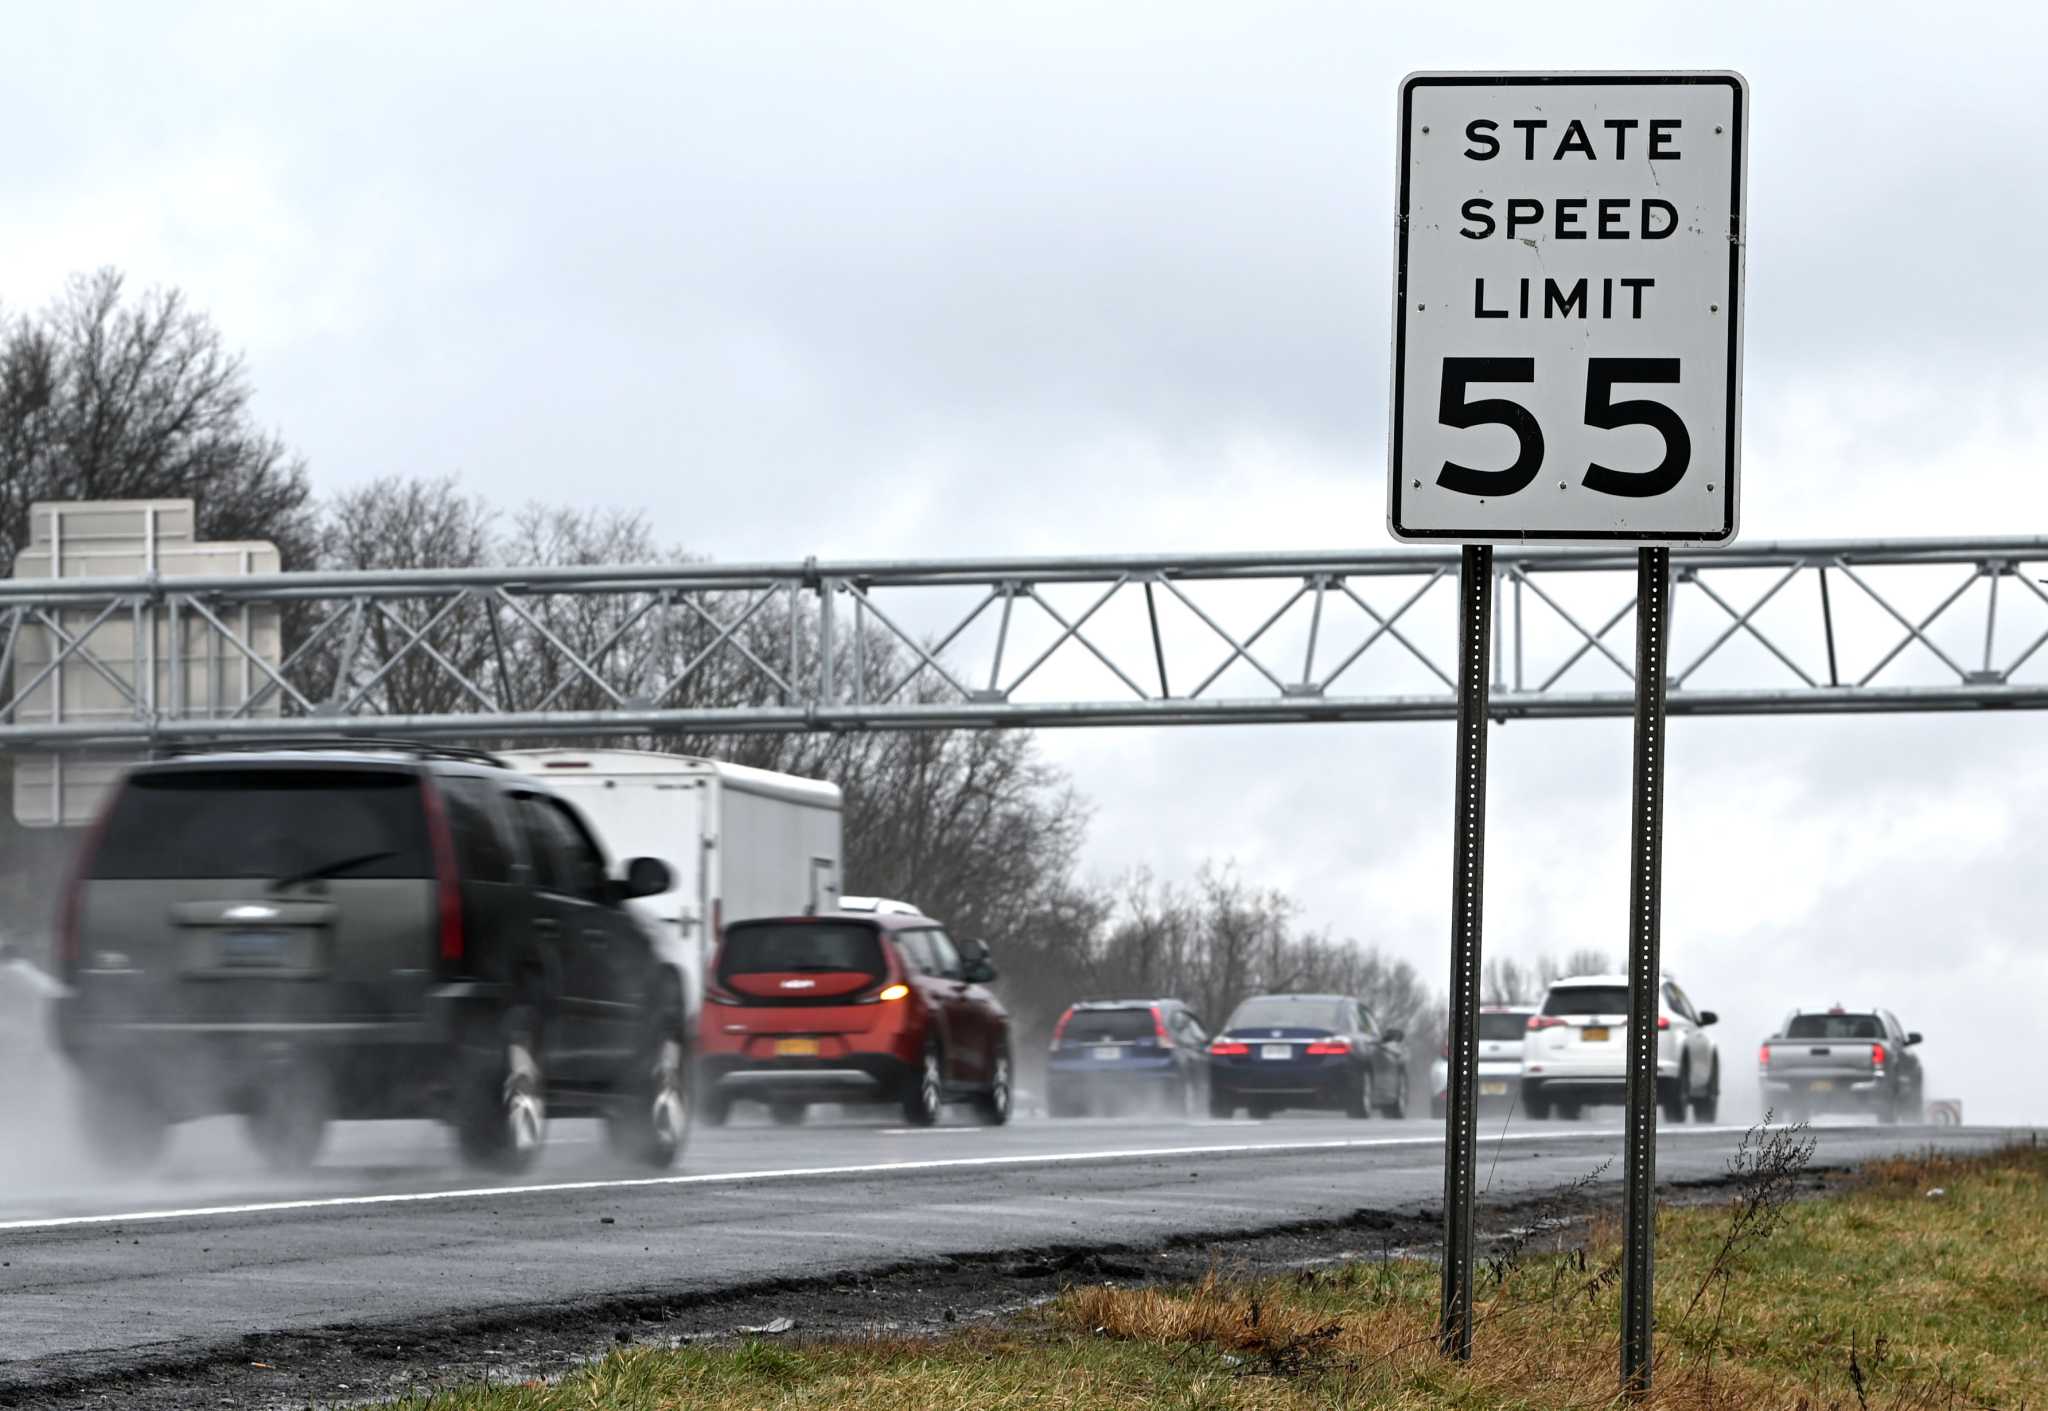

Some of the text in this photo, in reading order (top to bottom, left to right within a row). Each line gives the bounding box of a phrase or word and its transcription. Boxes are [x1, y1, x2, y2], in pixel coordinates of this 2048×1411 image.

[1463, 118, 1682, 162] STATE
[1459, 198, 1679, 240] SPEED
[1474, 277, 1656, 319] LIMIT
[1435, 356, 1692, 498] 55
